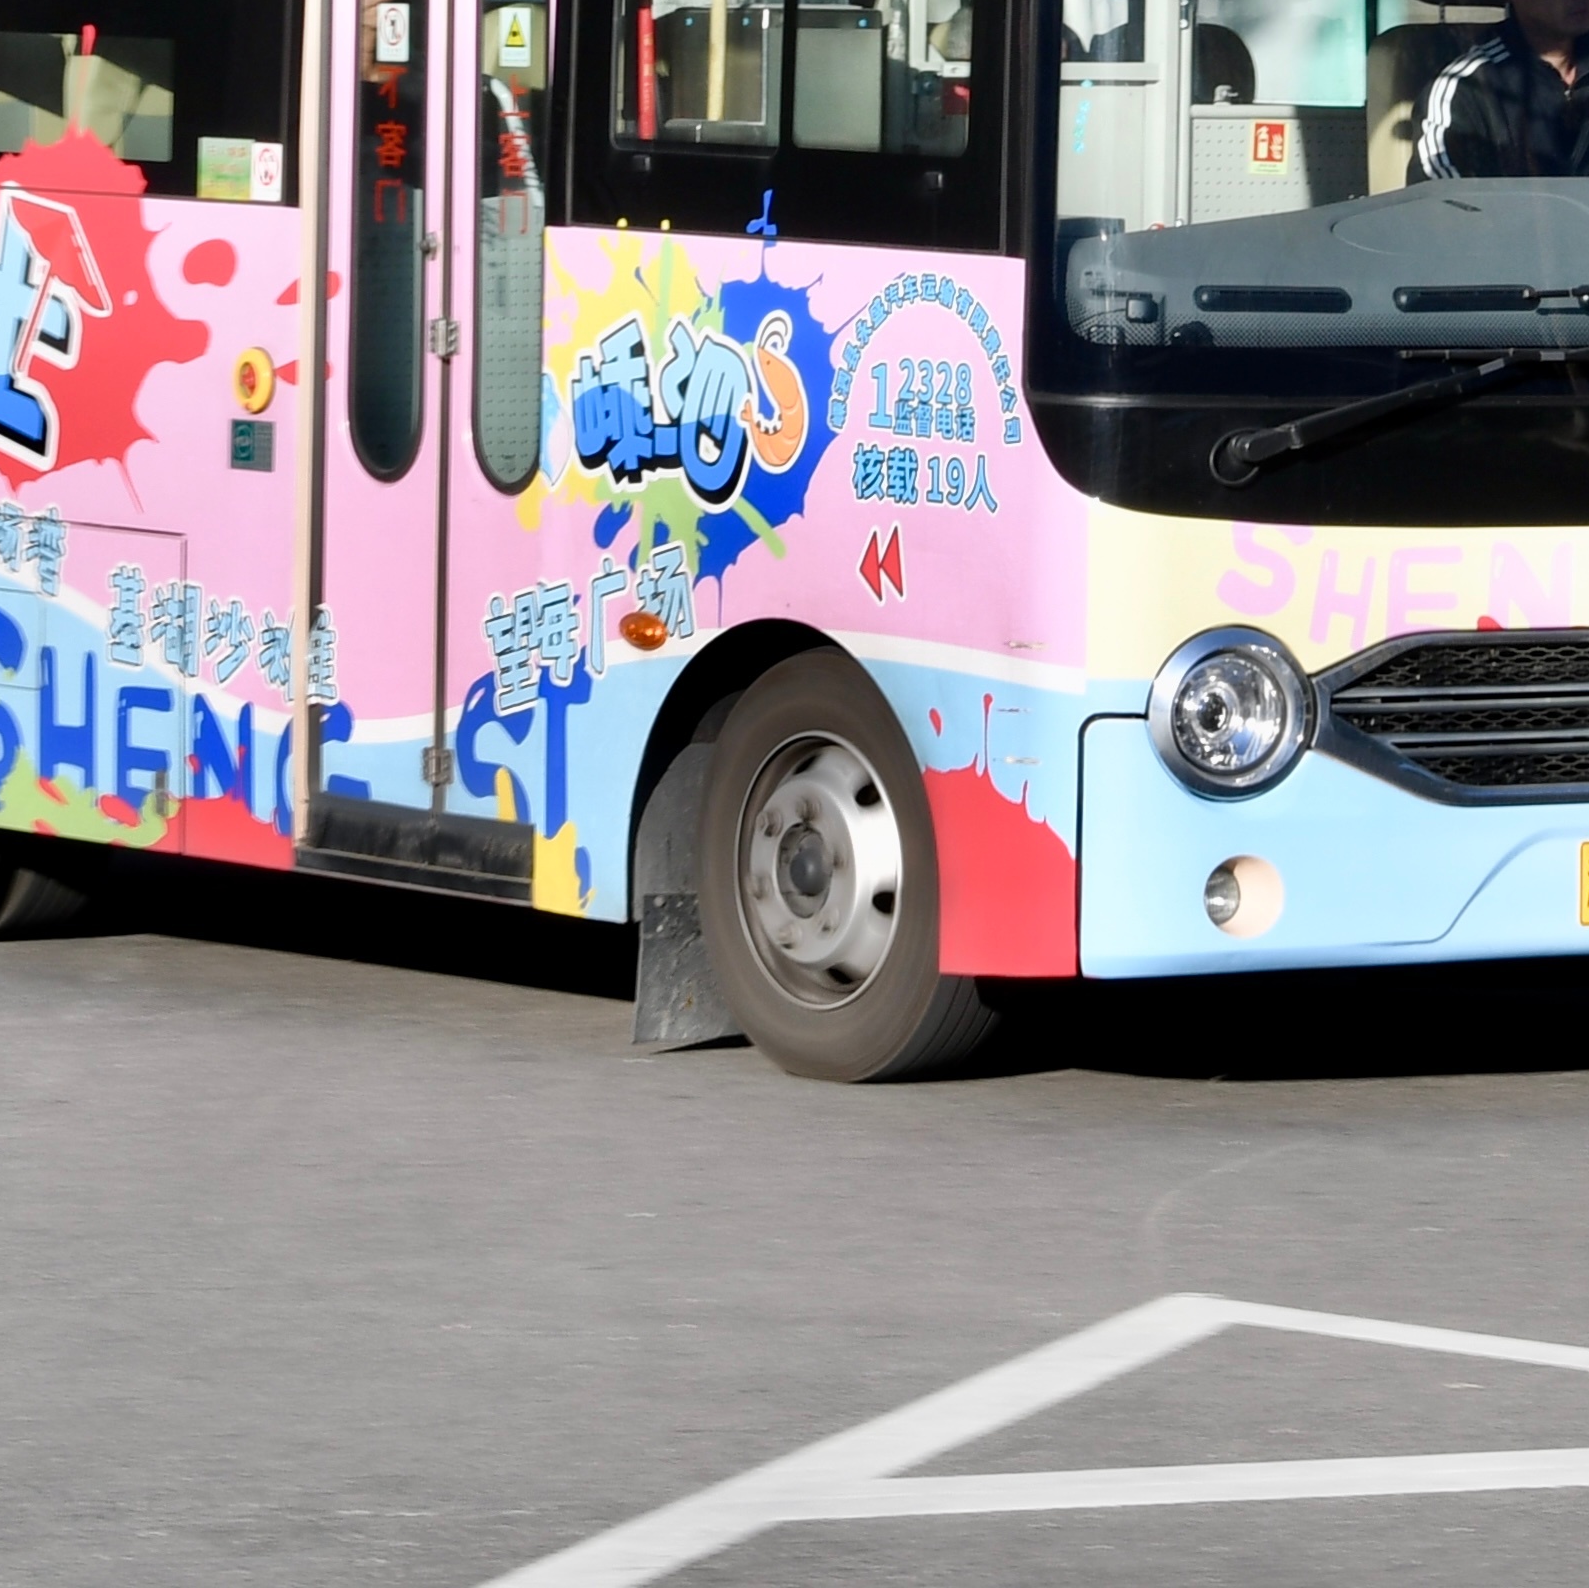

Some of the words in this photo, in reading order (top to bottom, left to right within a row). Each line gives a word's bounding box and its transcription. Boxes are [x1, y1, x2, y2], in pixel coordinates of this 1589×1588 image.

[572, 319, 750, 504] 嵊泗
[869, 358, 972, 429] 12328
[893, 398, 976, 443] 监督电话
[484, 546, 694, 711] 望海广场
